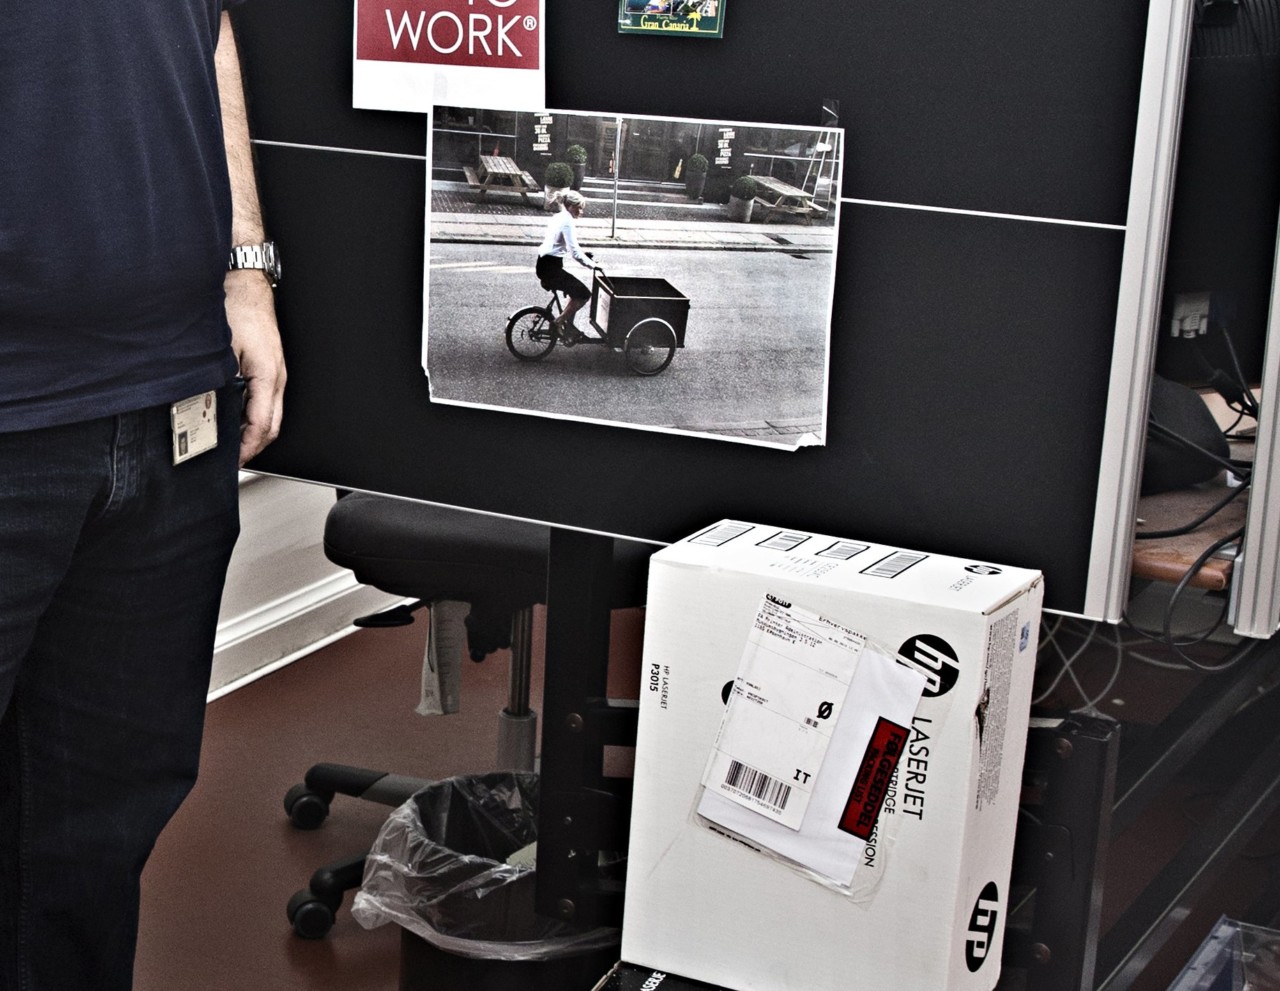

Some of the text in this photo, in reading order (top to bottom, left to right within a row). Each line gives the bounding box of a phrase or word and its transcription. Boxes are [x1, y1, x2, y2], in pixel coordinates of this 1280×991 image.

[641, 15, 659, 28] Gran
[662, 19, 690, 29] Canaria
[649, 663, 660, 692] P3015
[660, 665, 670, 709] HP LASERJET
[793, 768, 811, 784] IT
[903, 716, 933, 820] LASERJET
[853, 785, 866, 804] LIST
